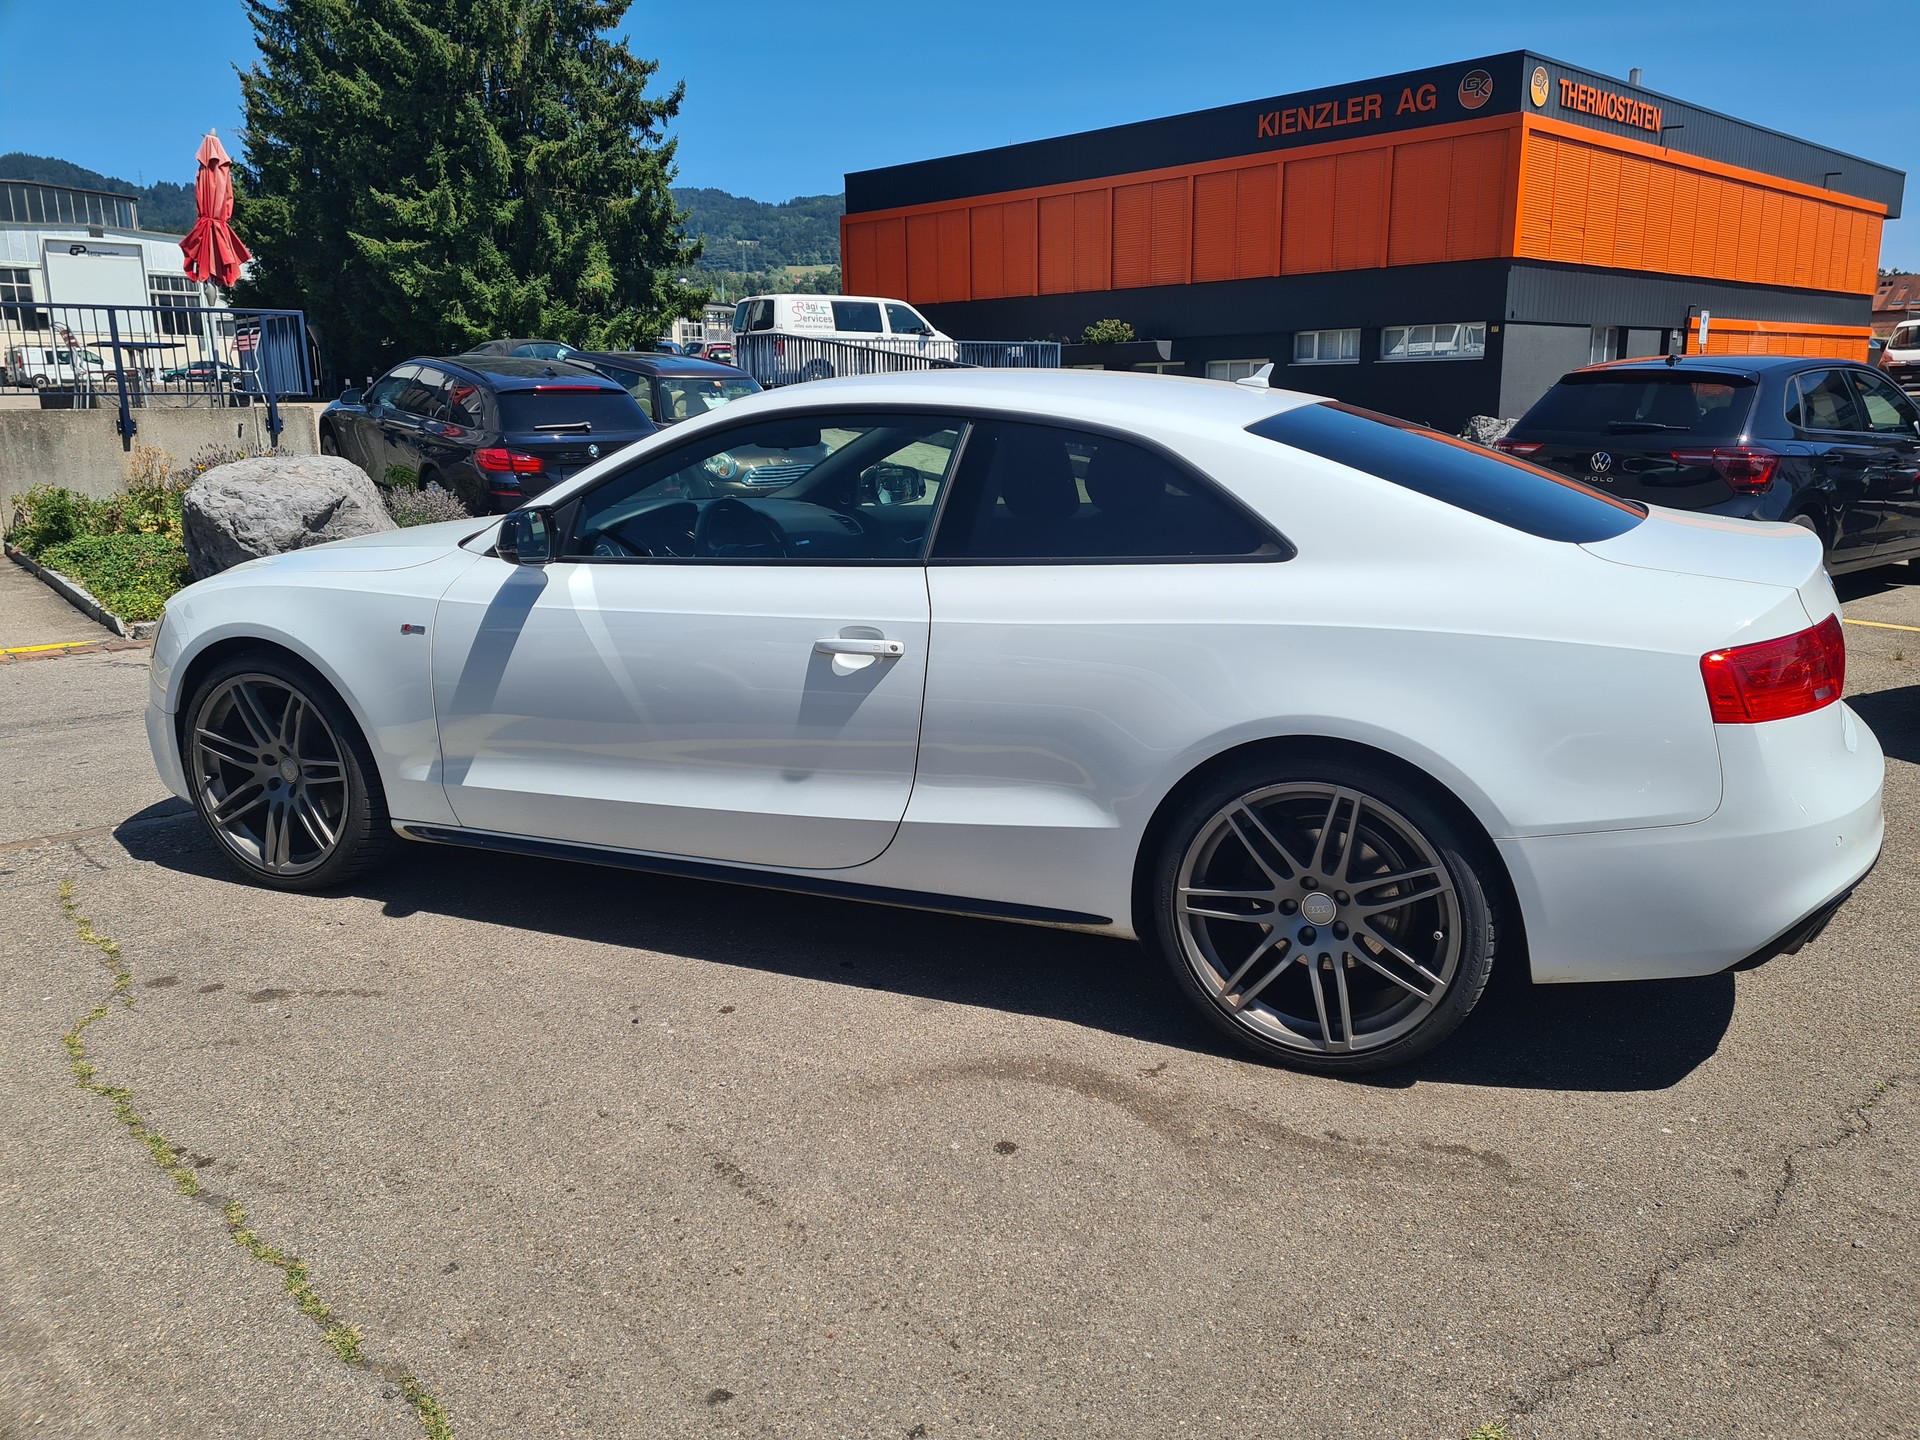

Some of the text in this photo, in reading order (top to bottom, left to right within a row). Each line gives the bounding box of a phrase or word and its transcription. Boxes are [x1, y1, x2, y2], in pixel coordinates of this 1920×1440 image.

[1258, 83, 1437, 138] KIENZLER AG
[1559, 78, 1662, 133] THERMOSTATEN
[792, 306, 833, 323] Services
